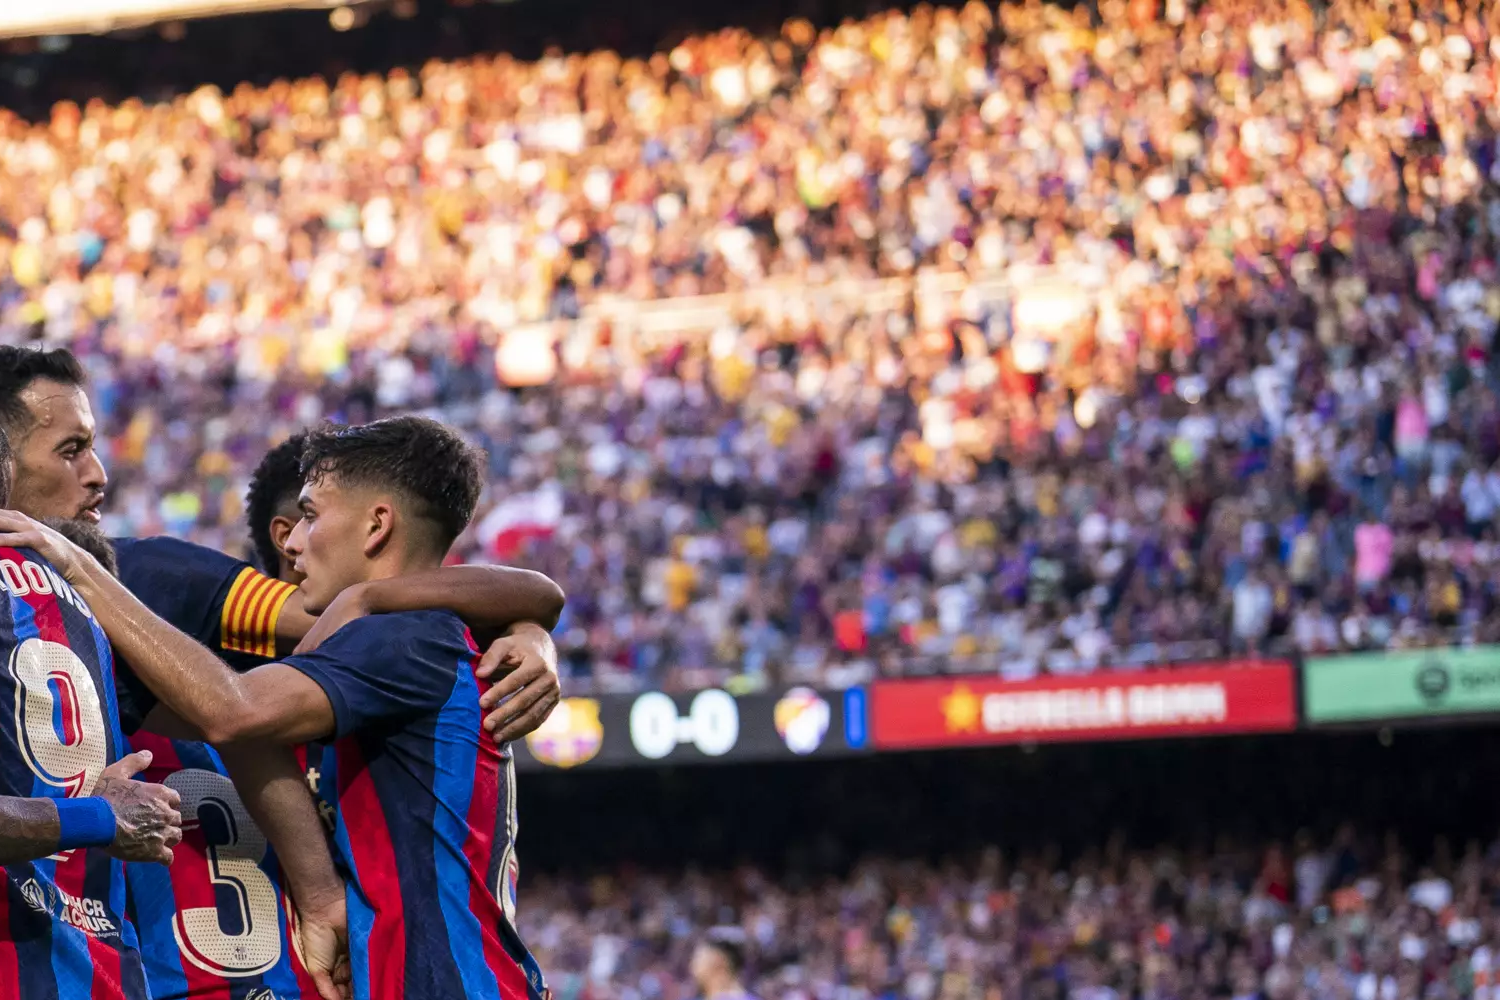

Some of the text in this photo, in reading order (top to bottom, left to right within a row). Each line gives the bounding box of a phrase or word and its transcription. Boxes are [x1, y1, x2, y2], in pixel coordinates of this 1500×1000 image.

[9, 637, 107, 862] 9
[629, 689, 739, 759] 0-0
[60, 905, 116, 931] ACNUR
